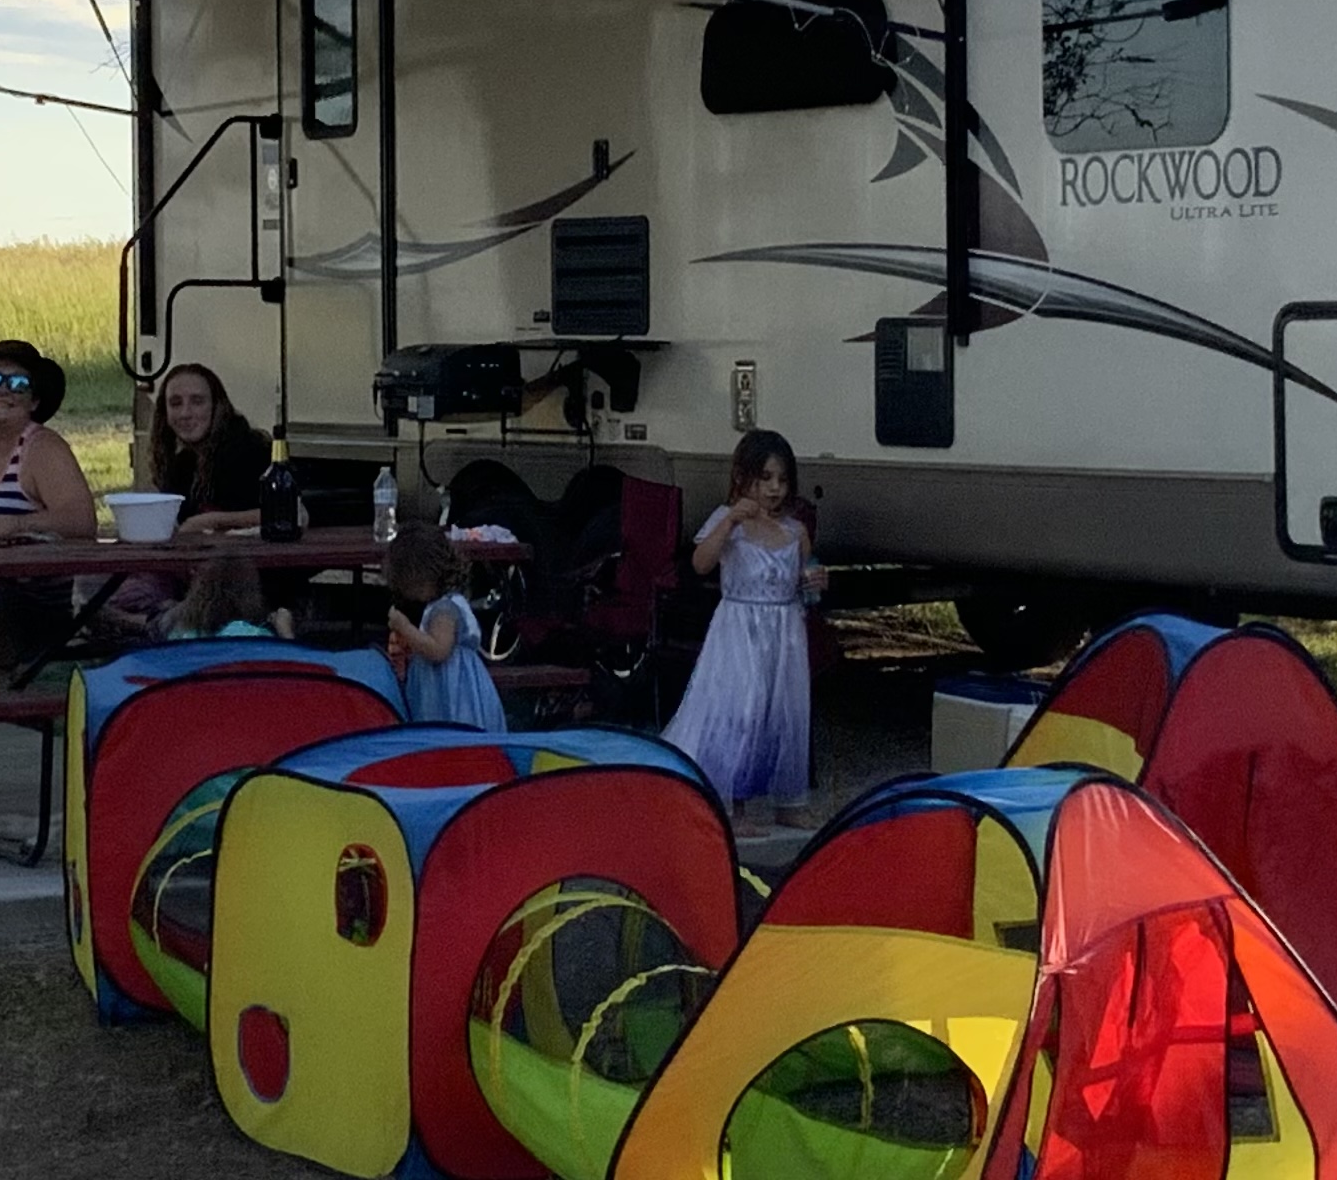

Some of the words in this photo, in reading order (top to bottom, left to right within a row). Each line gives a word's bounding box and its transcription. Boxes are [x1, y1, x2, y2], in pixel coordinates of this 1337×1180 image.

[1059, 145, 1282, 207] ROCKWOOD
[1170, 205, 1232, 221] ULTRA
[1239, 203, 1279, 218] LITE
